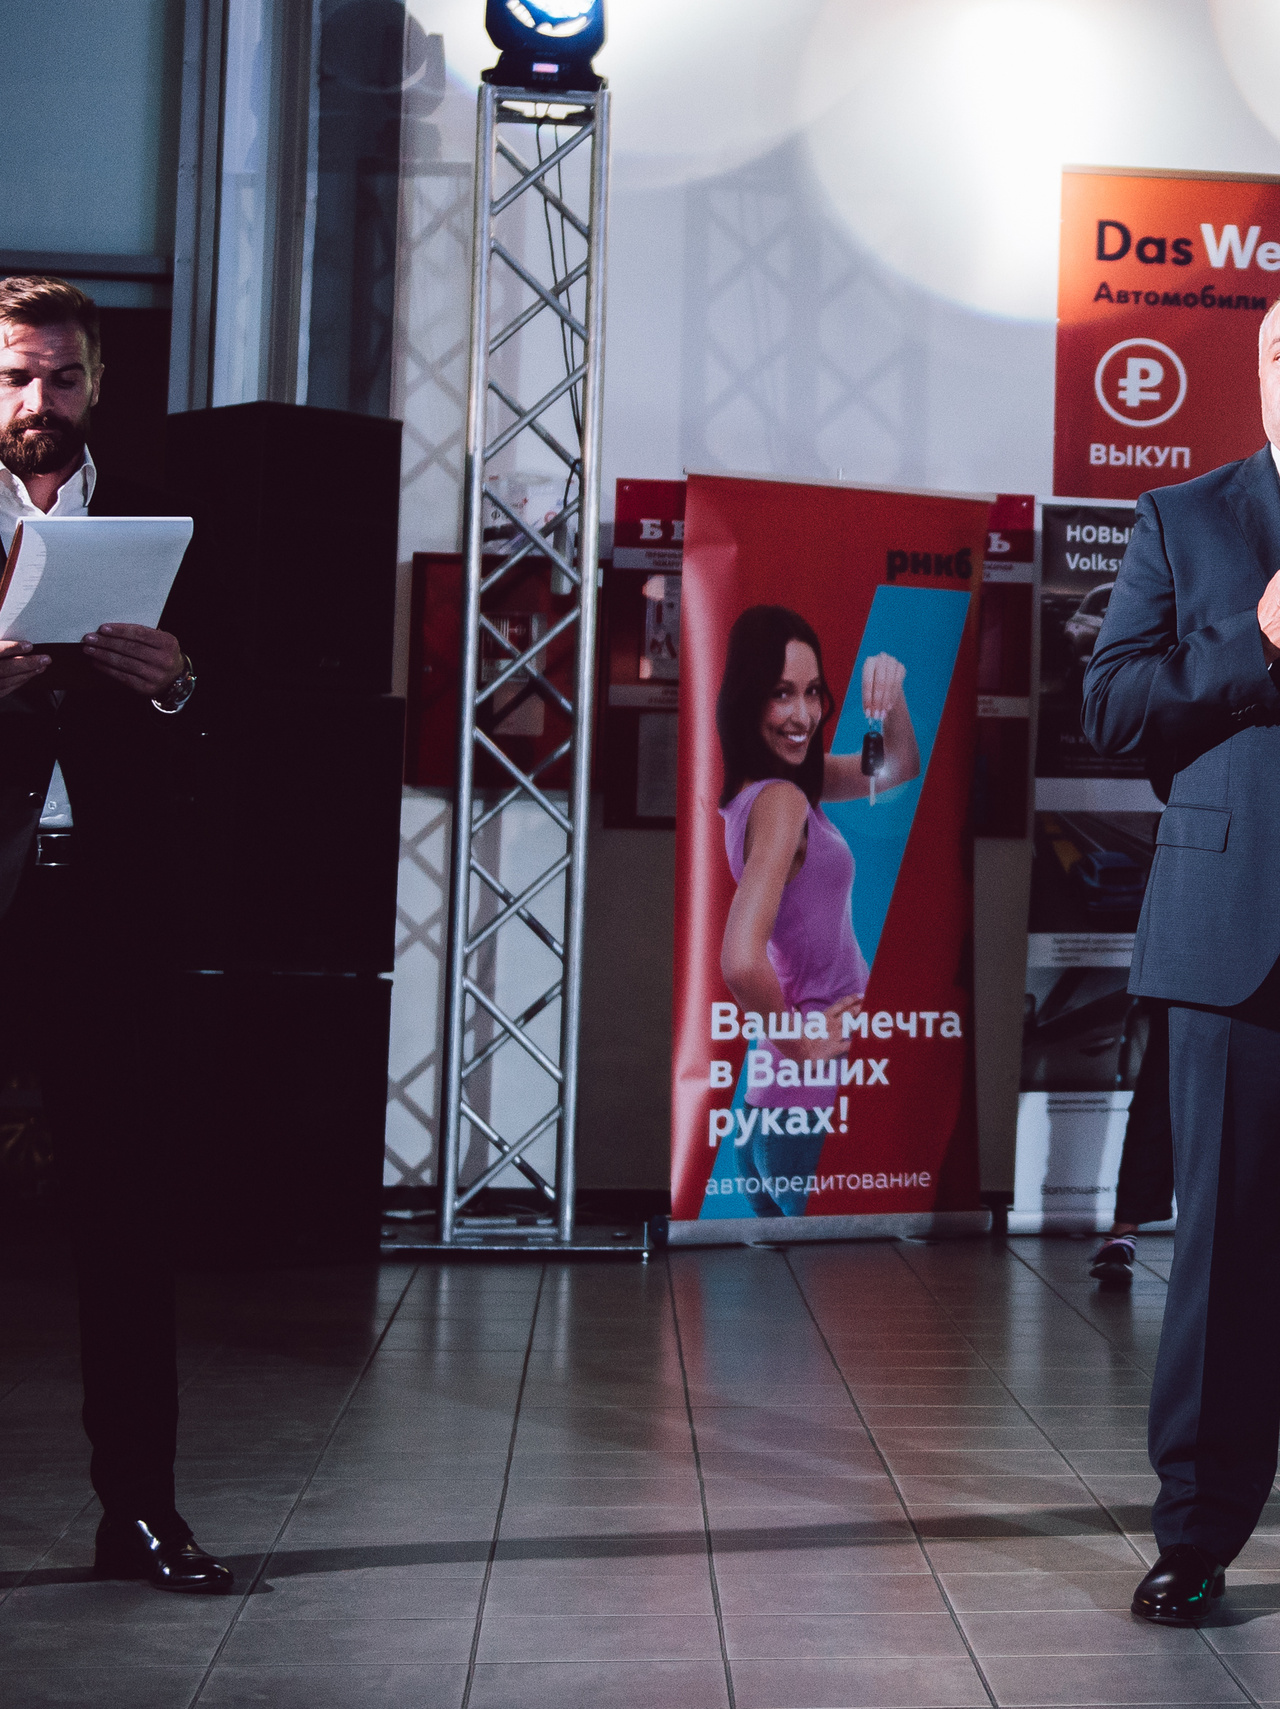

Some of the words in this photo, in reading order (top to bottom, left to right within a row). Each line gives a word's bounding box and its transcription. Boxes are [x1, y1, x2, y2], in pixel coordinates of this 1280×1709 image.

[1095, 219, 1193, 266] Das
[1093, 282, 1267, 310] Автомобили
[1089, 443, 1191, 470] ВЫКУП
[886, 548, 973, 581] рнкб
[710, 1002, 829, 1041] Ваша
[842, 1009, 963, 1040] мечта
[709, 1059, 732, 1089] в
[746, 1050, 889, 1088] Ваших
[707, 1096, 849, 1147] руках!
[705, 1169, 932, 1197] автокредитование
